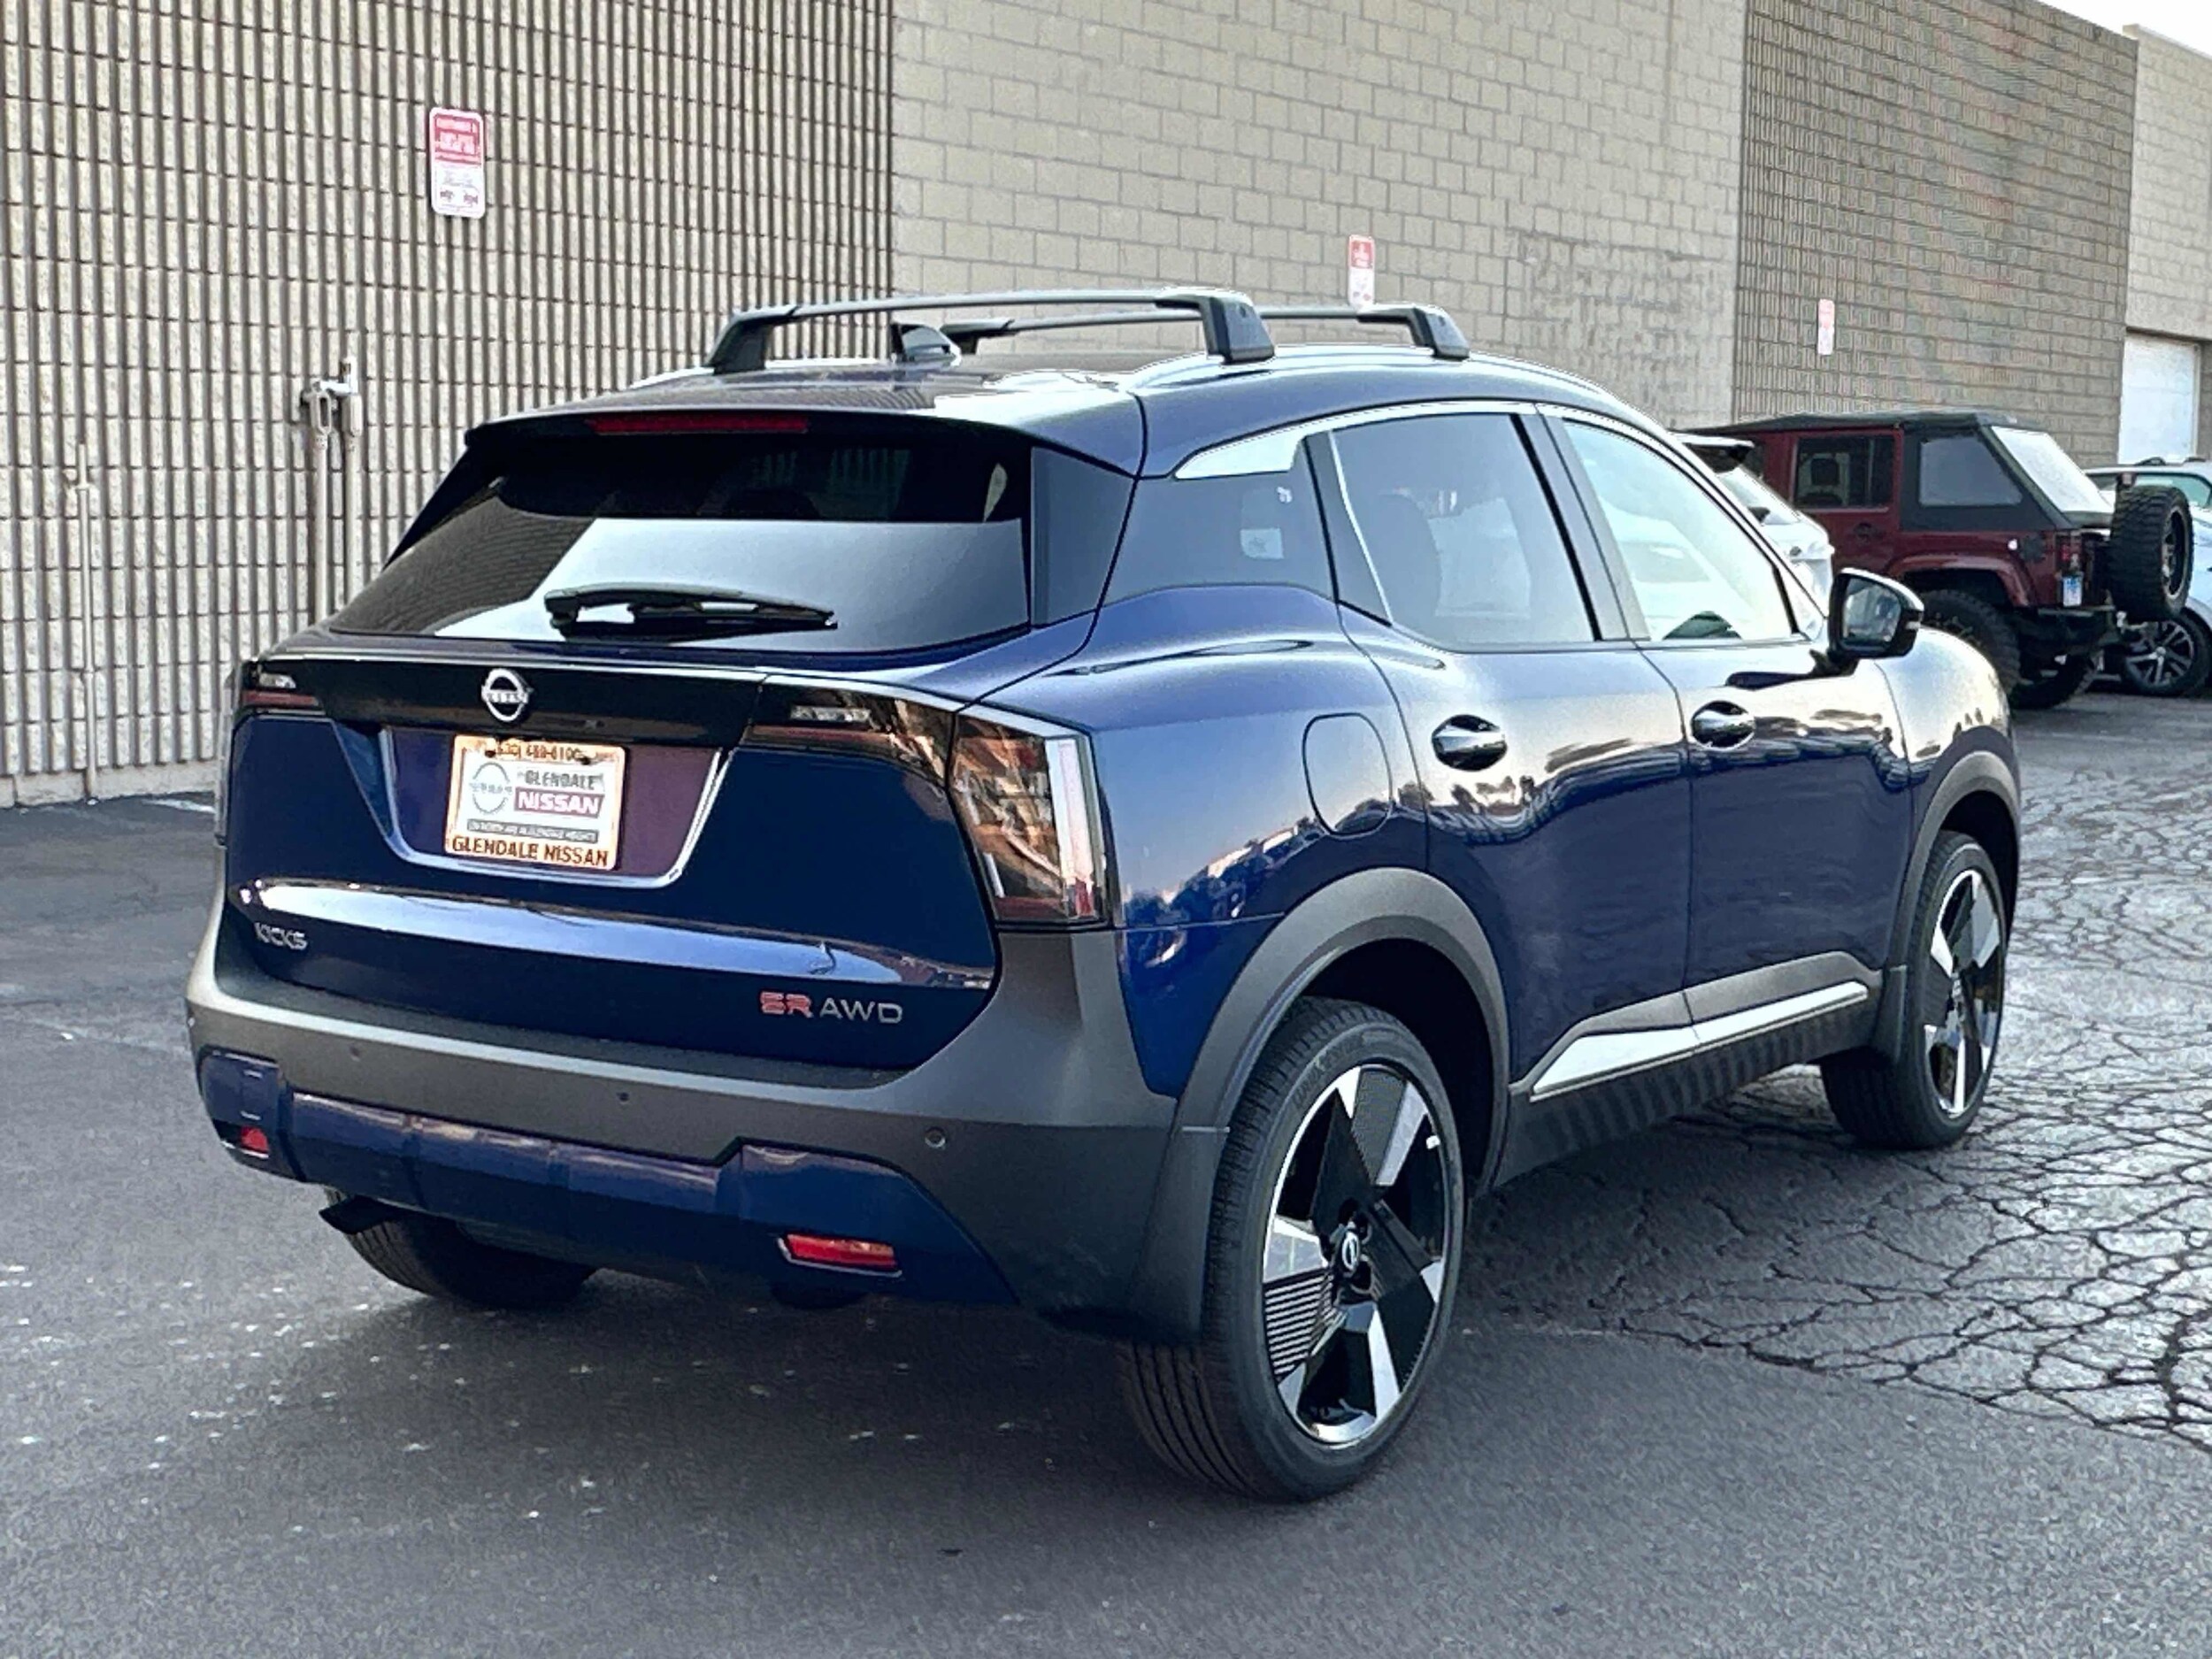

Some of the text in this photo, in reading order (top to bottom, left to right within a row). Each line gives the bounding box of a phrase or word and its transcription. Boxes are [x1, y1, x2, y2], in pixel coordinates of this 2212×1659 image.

[525, 770, 596, 790] GLENDALE
[517, 790, 600, 815] NISSAN
[451, 836, 609, 867] GLENDALE NISSAN
[254, 922, 308, 950] KICKS
[819, 997, 903, 1024] AWD
